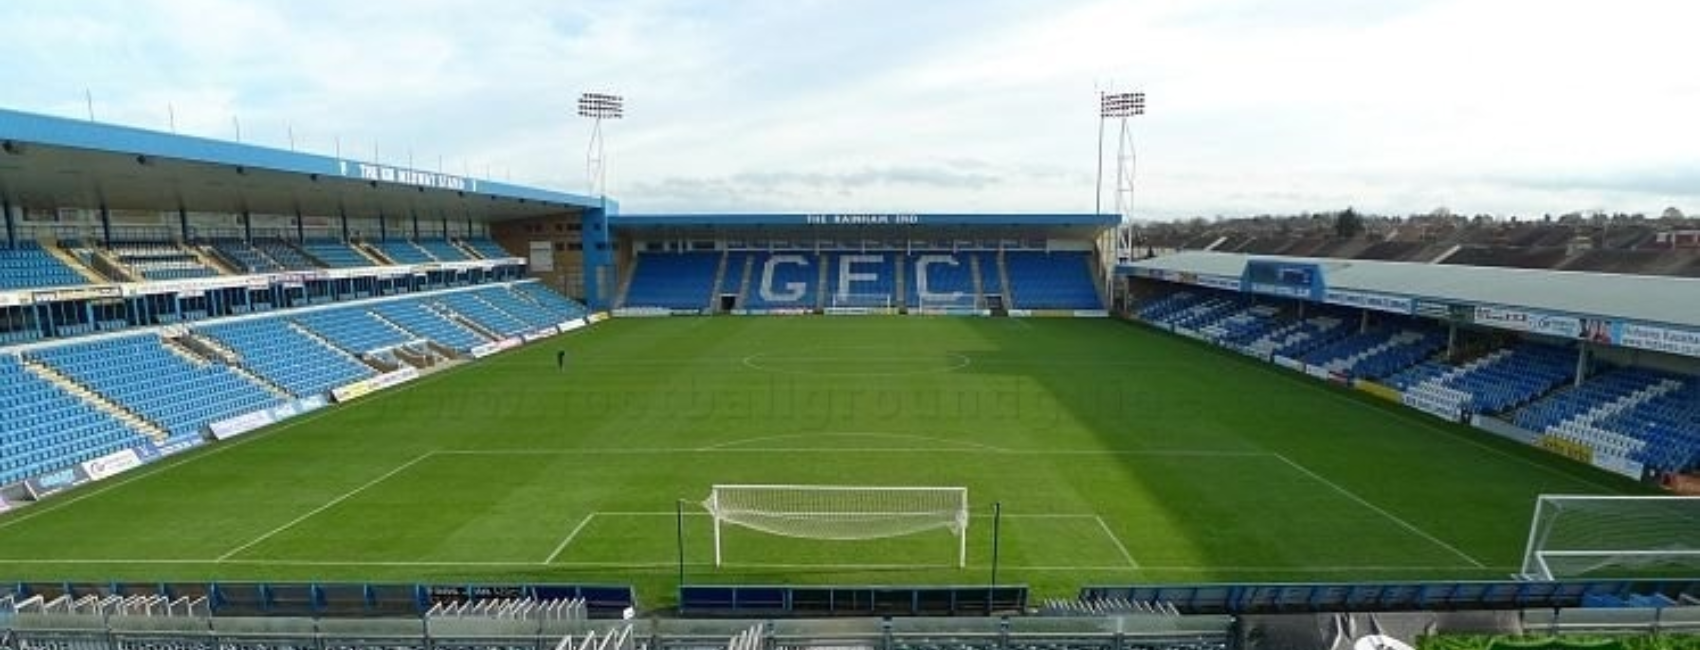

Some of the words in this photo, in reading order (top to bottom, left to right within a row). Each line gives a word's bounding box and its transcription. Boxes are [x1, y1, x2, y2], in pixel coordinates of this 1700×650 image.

[806, 214, 827, 224] THE
[835, 214, 888, 224] RAINHAM
[896, 214, 919, 224] END
[759, 253, 965, 301] GFC
